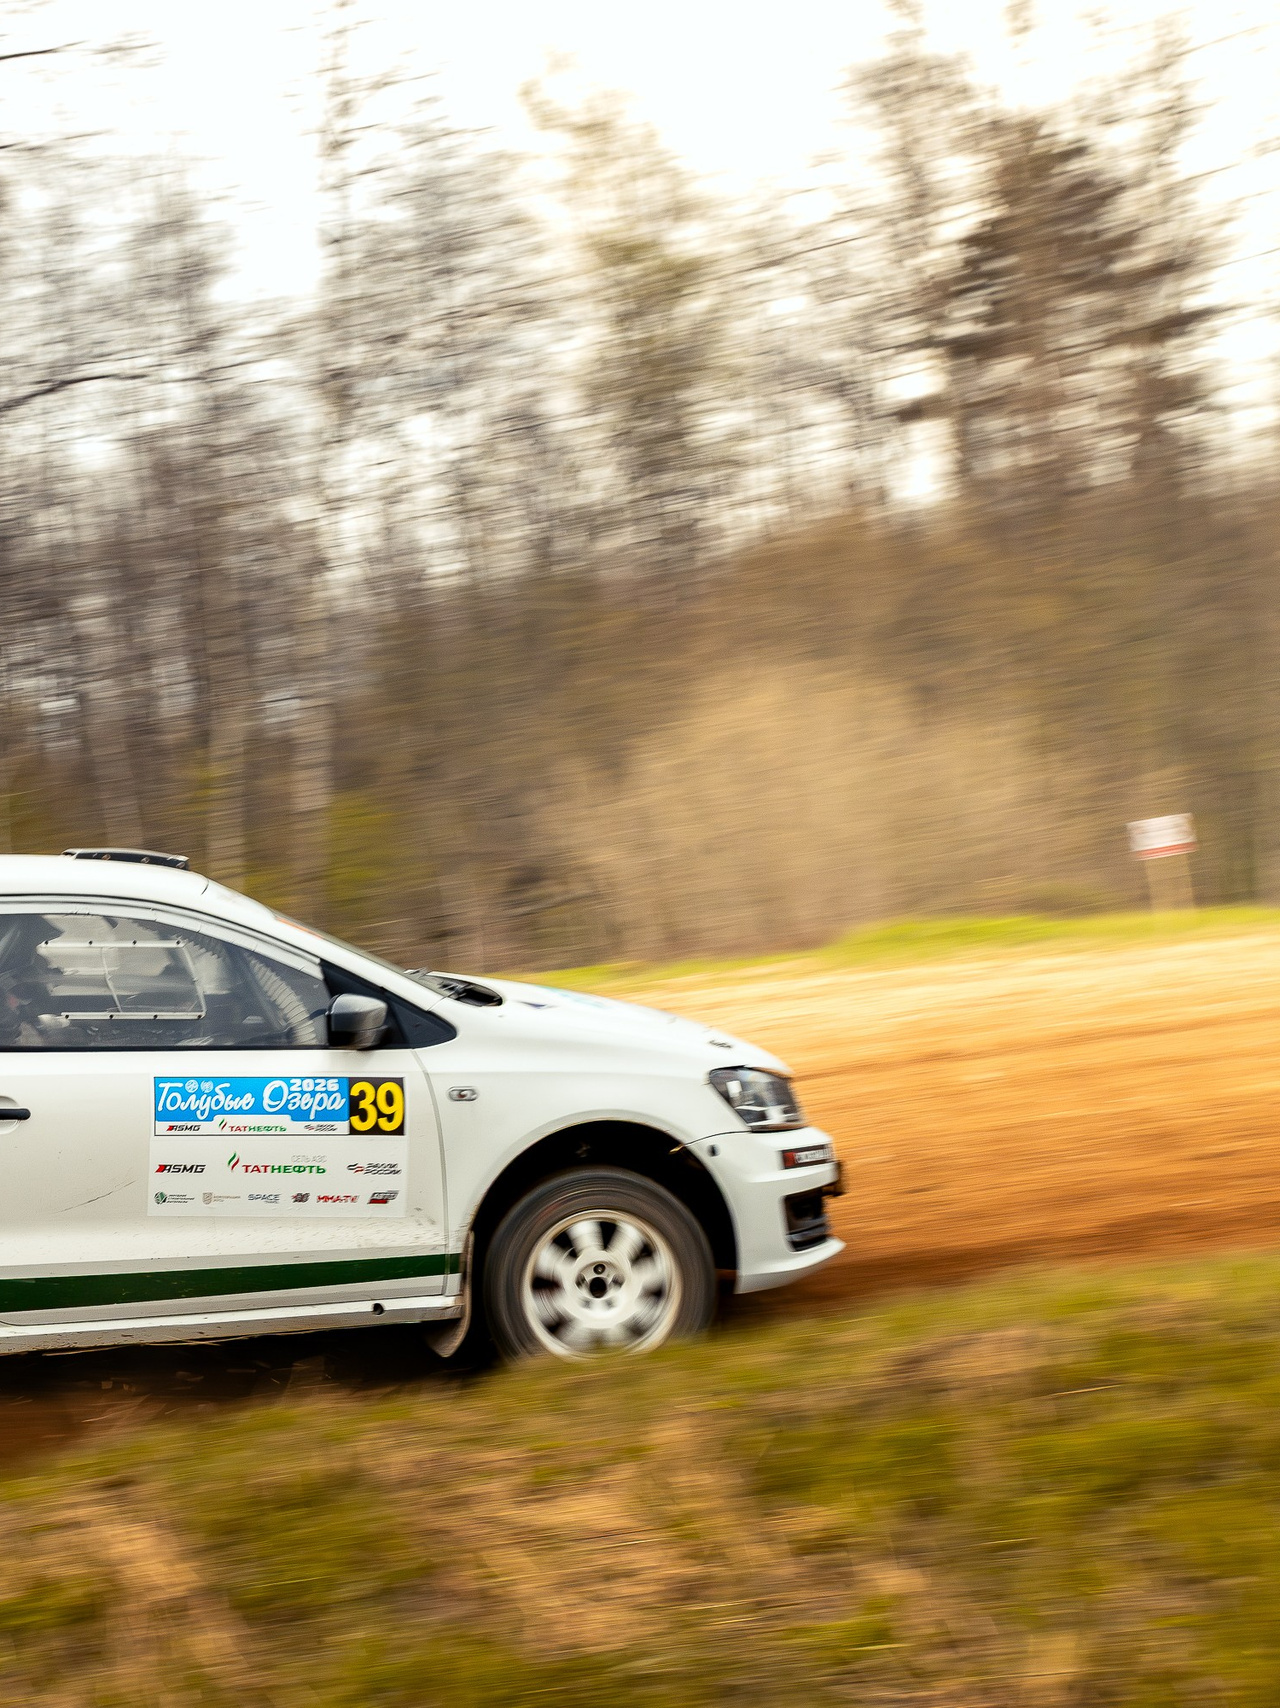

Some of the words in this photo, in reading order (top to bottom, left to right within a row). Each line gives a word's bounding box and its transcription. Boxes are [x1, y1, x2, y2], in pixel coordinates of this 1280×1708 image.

[289, 1078, 339, 1092] 2026
[157, 1082, 255, 1120] Голубые
[262, 1080, 347, 1120] Озера
[349, 1081, 405, 1133] 39
[242, 1164, 327, 1174] ТАТНЕФТЬ
[248, 1193, 281, 1201] SPACE
